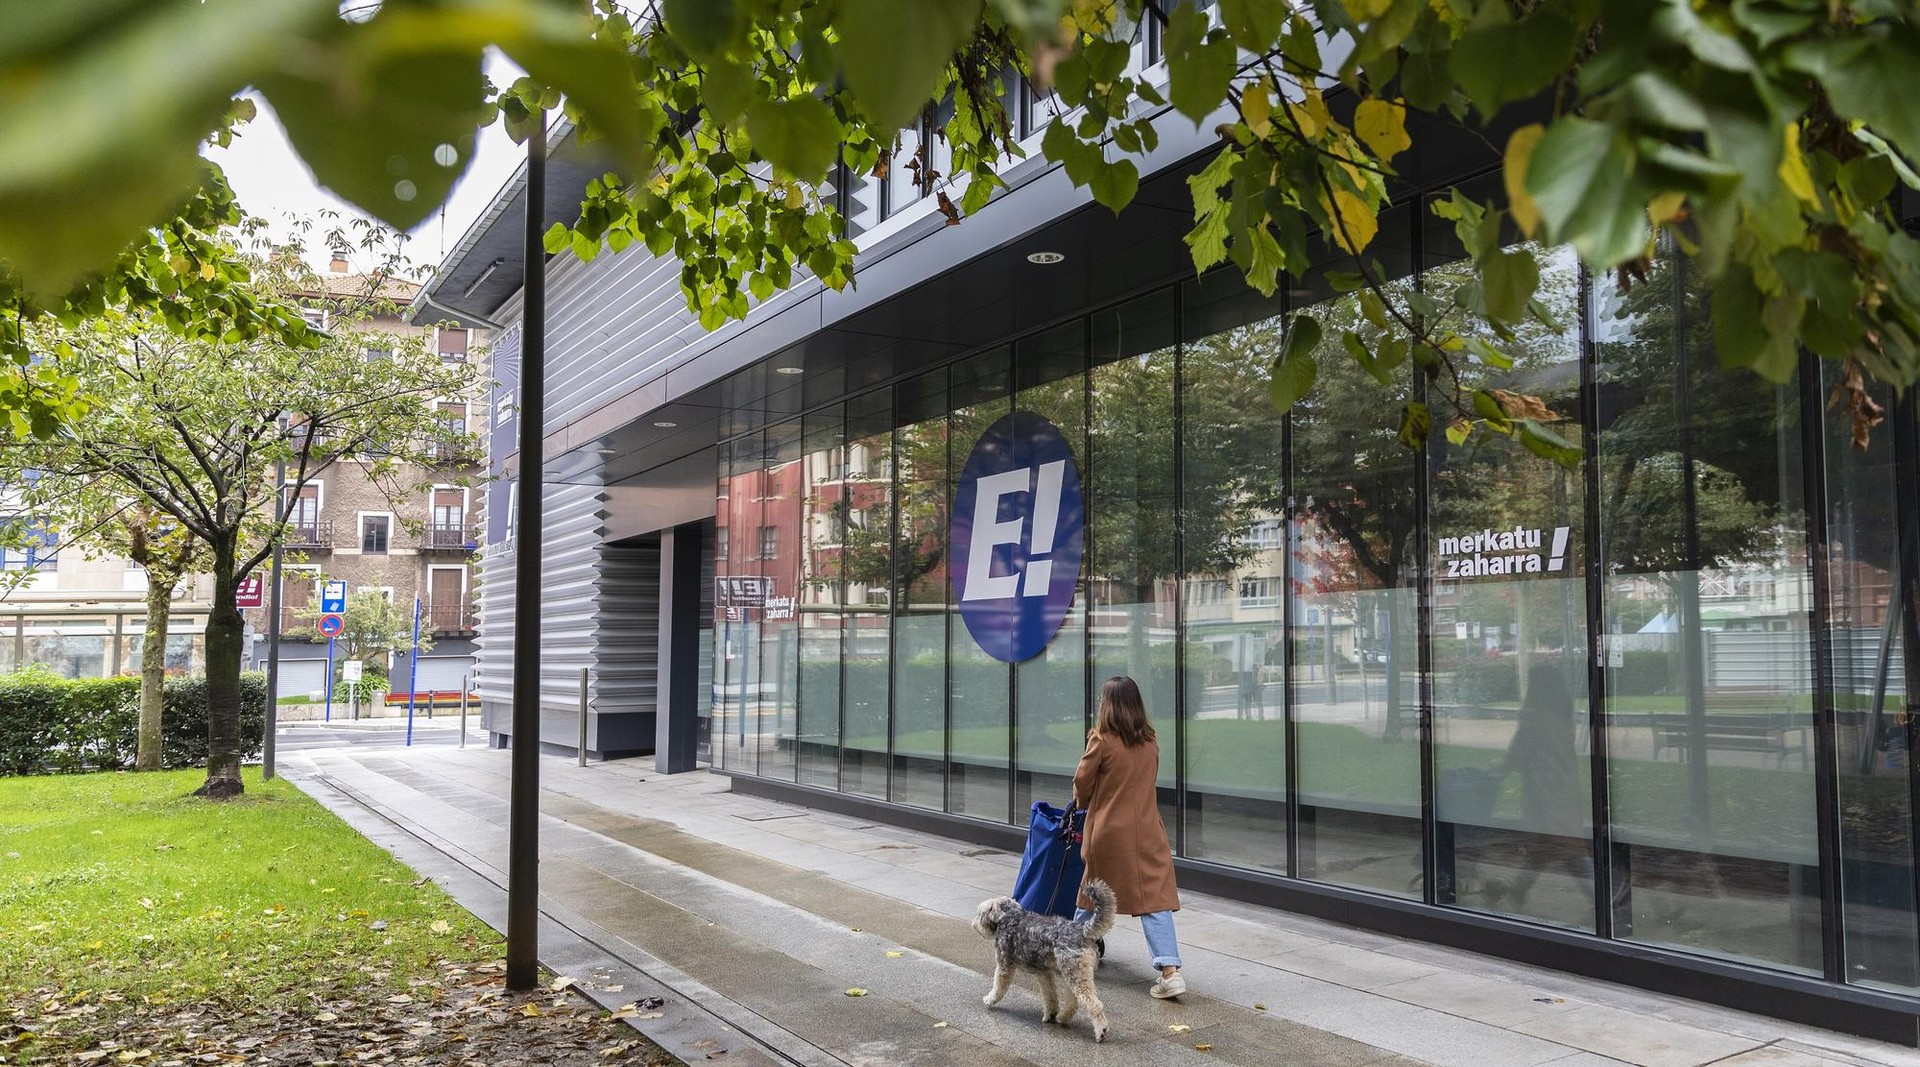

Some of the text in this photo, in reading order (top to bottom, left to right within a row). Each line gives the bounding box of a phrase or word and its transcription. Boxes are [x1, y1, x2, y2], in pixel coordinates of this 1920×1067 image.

[962, 459, 1066, 602] E!
[1439, 526, 1541, 555] merkatu
[1447, 553, 1542, 577] zaharra
[765, 595, 789, 608] merkatu
[766, 607, 789, 619] zaharra
